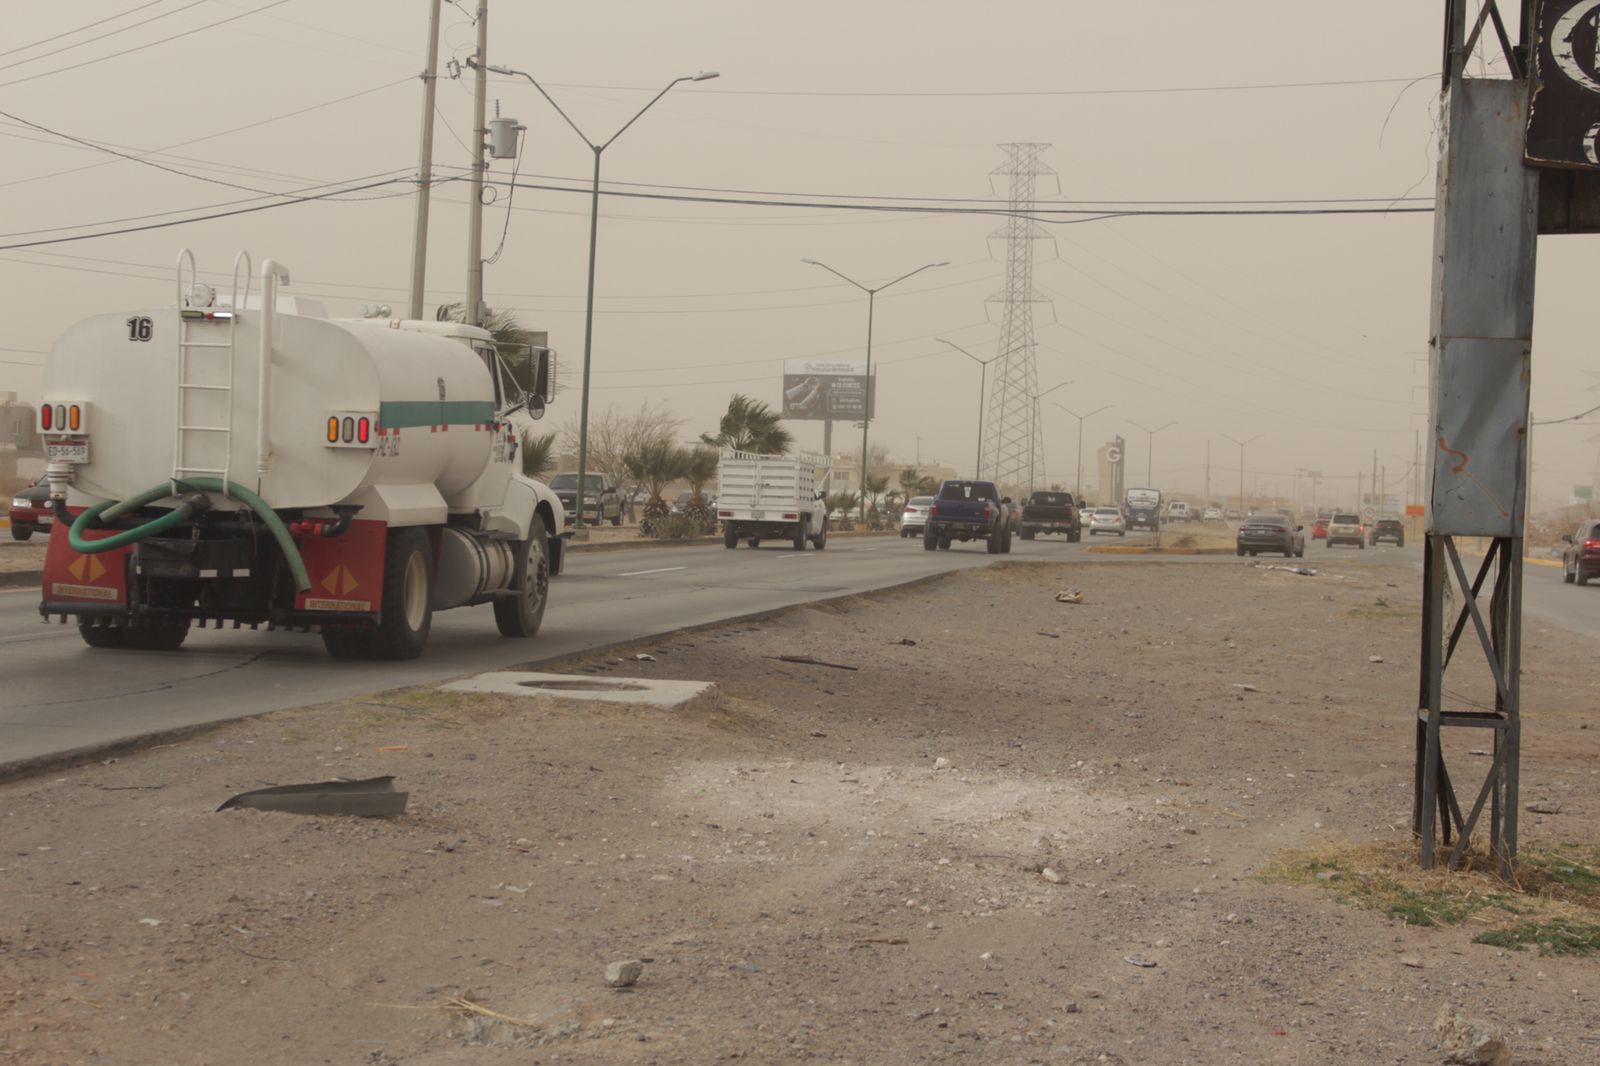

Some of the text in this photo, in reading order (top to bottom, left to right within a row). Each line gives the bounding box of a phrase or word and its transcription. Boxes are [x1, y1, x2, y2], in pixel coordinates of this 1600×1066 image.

[126, 316, 153, 342] 16
[1106, 447, 1121, 462] G
[57, 585, 113, 599] INTERNATIONAL
[310, 600, 365, 610] INTERNATIONAL
